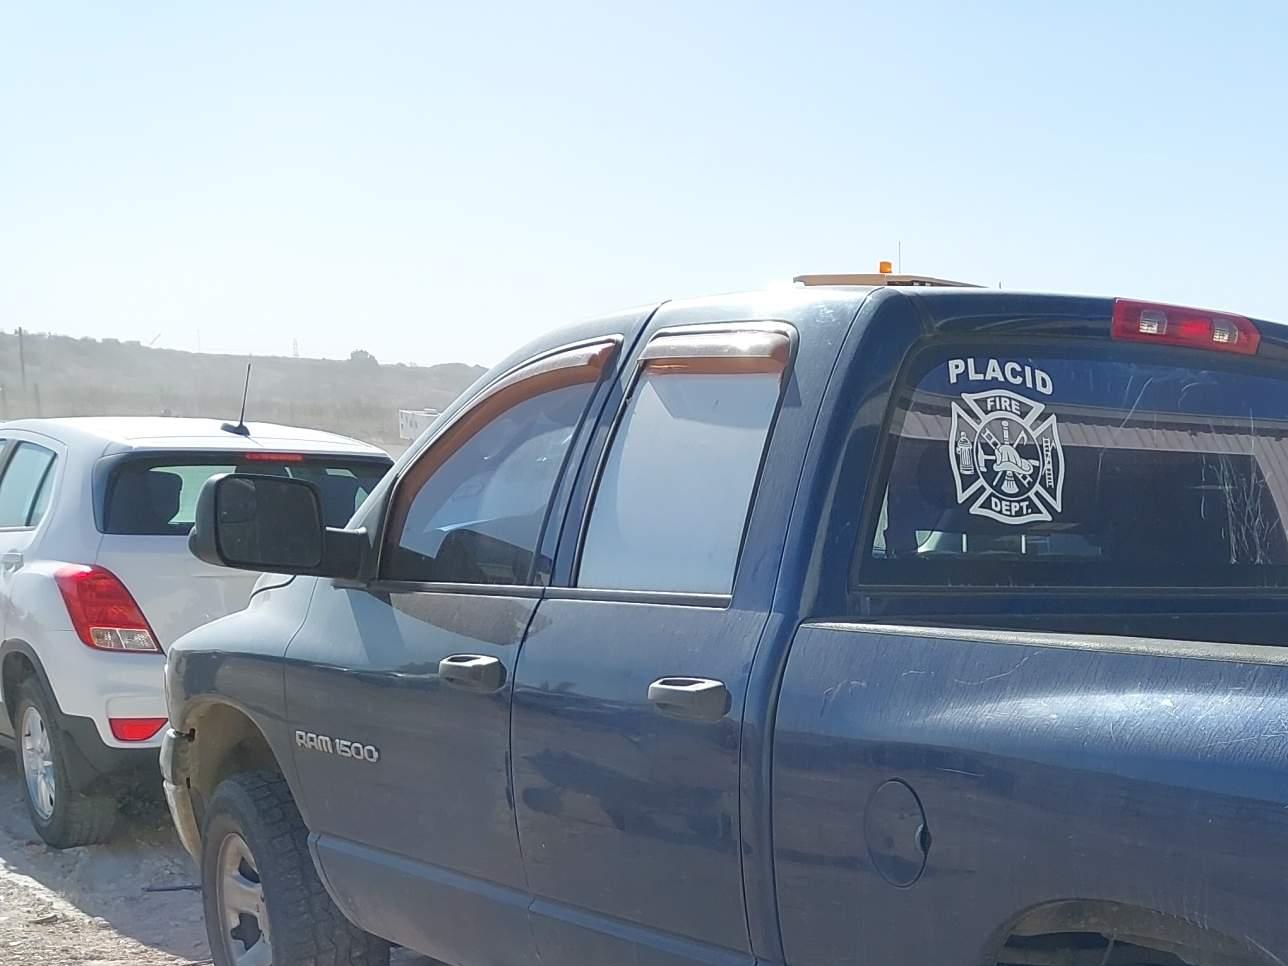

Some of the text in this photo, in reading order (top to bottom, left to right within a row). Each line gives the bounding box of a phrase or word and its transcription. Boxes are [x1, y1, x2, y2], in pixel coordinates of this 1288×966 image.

[948, 357, 1053, 395] PLACID
[986, 396, 1021, 416] FIRE
[991, 497, 1032, 515] DEPT.
[295, 730, 378, 762] RAM 1500
